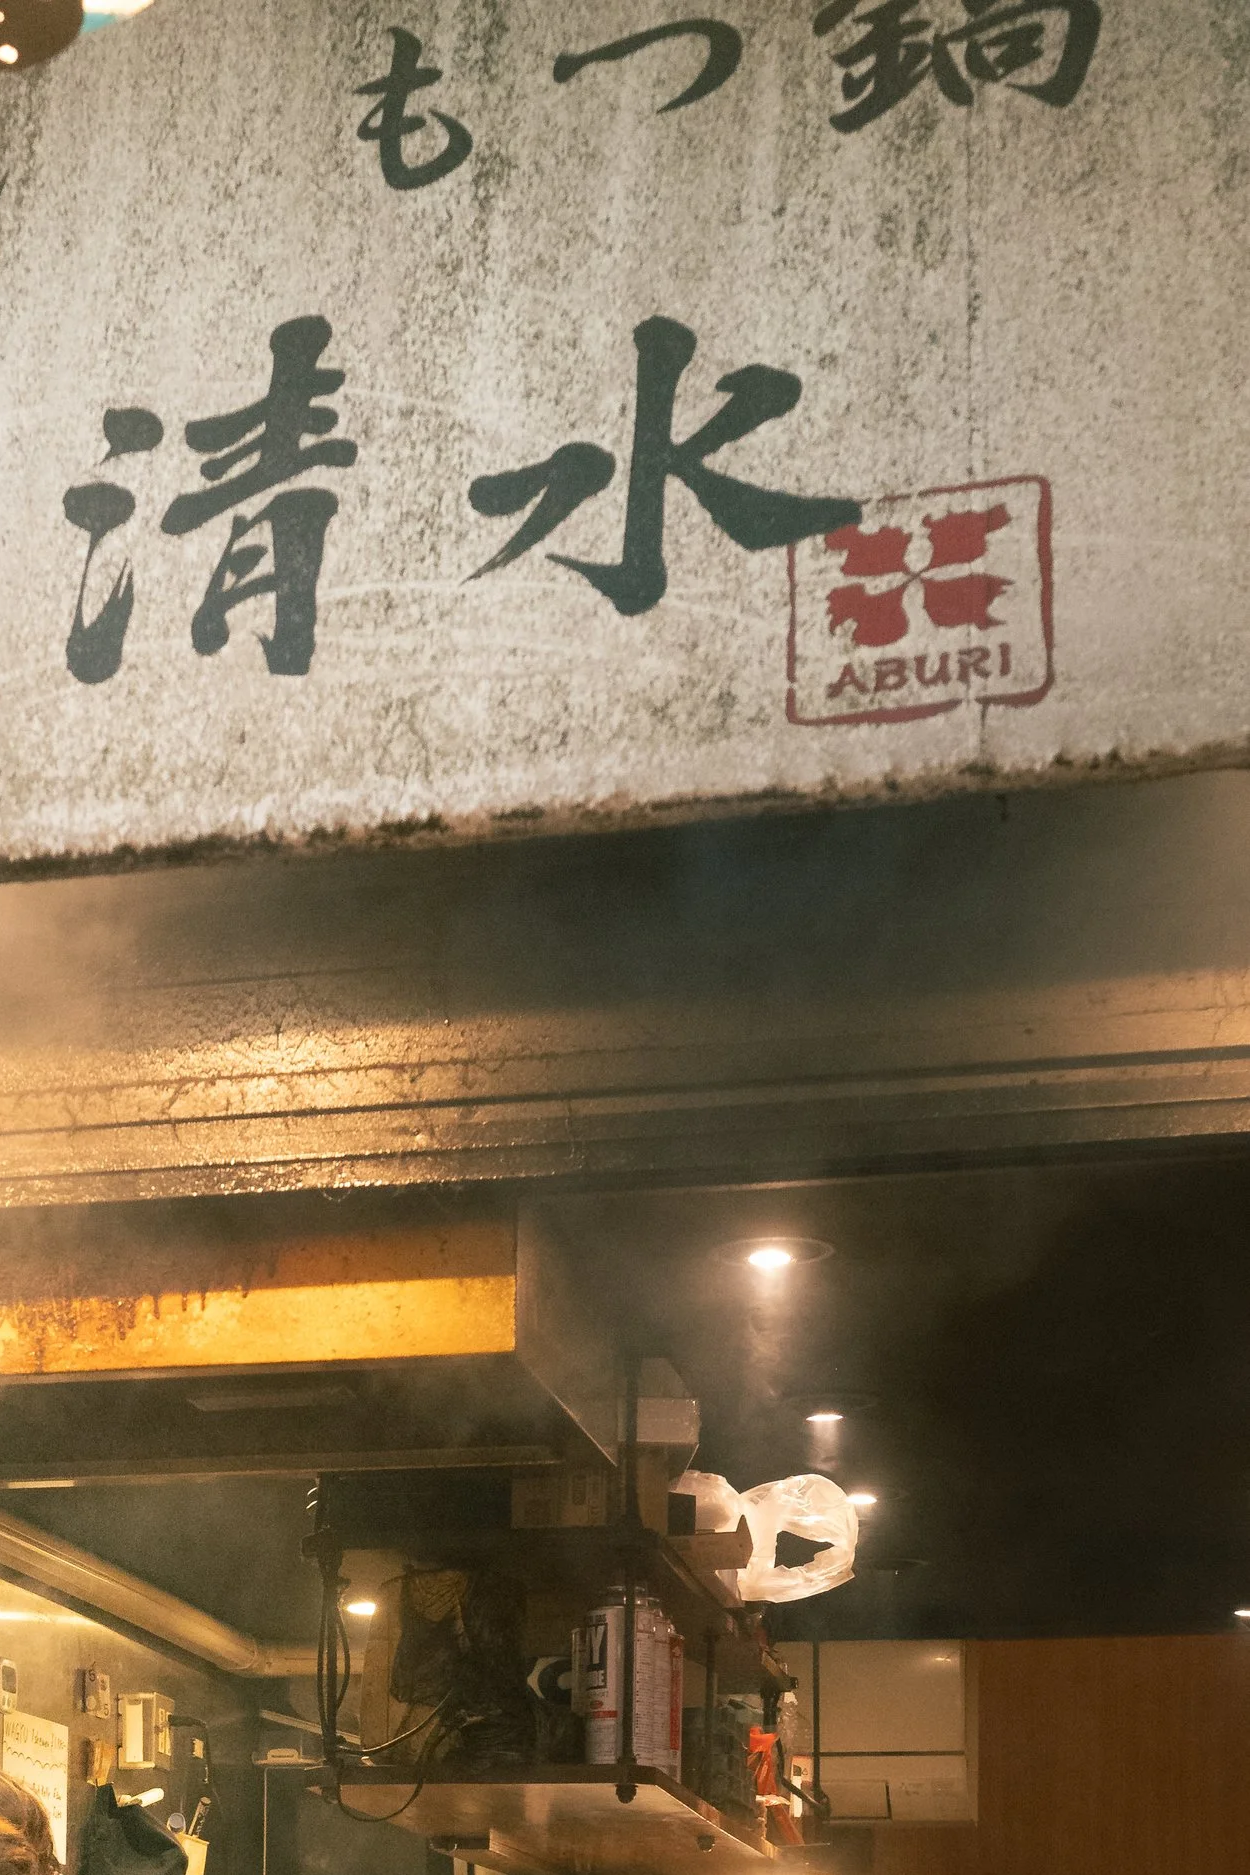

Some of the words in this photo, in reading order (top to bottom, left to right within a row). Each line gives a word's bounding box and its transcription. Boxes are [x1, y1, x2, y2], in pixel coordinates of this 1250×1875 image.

[356, 0, 1105, 192] もつ鍋
[61, 314, 865, 686] 清水
[827, 643, 1014, 701] ABURI
